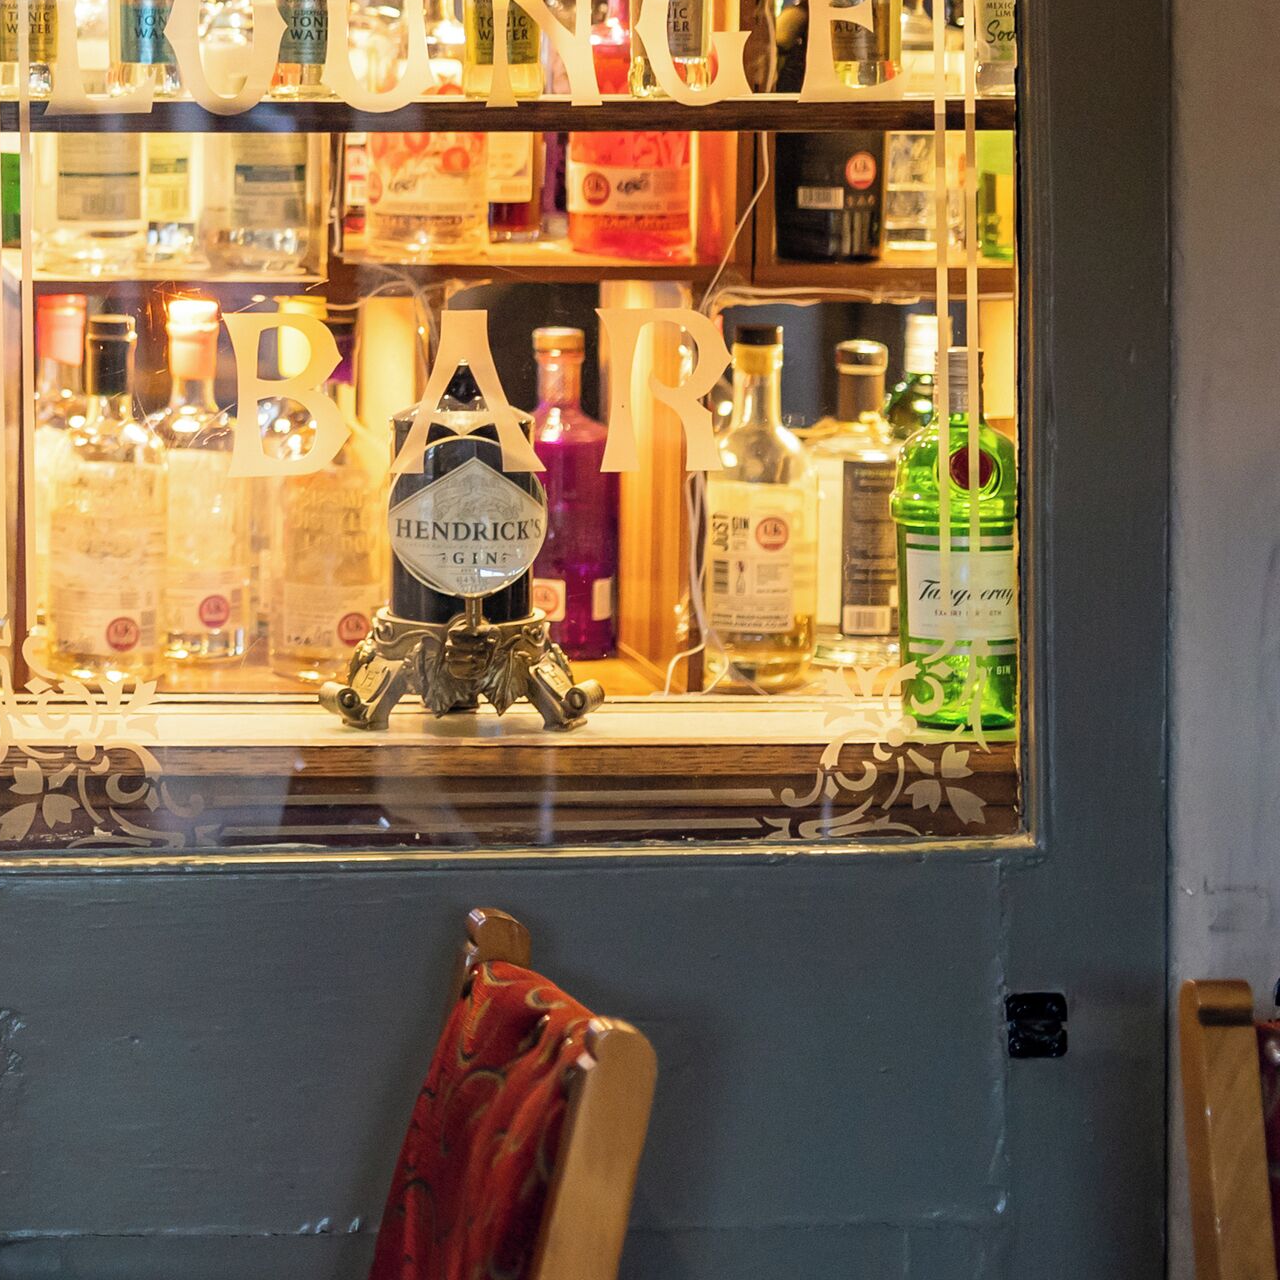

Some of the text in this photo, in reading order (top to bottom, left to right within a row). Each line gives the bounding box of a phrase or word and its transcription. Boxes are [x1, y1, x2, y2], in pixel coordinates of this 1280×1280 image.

[7, 11, 51, 23] TNIC
[6, 23, 52, 35] WTER
[478, 27, 529, 41] WTER
[221, 307, 736, 478] BAR
[395, 518, 543, 542] HENDRICK'S
[452, 551, 498, 565] GIN
